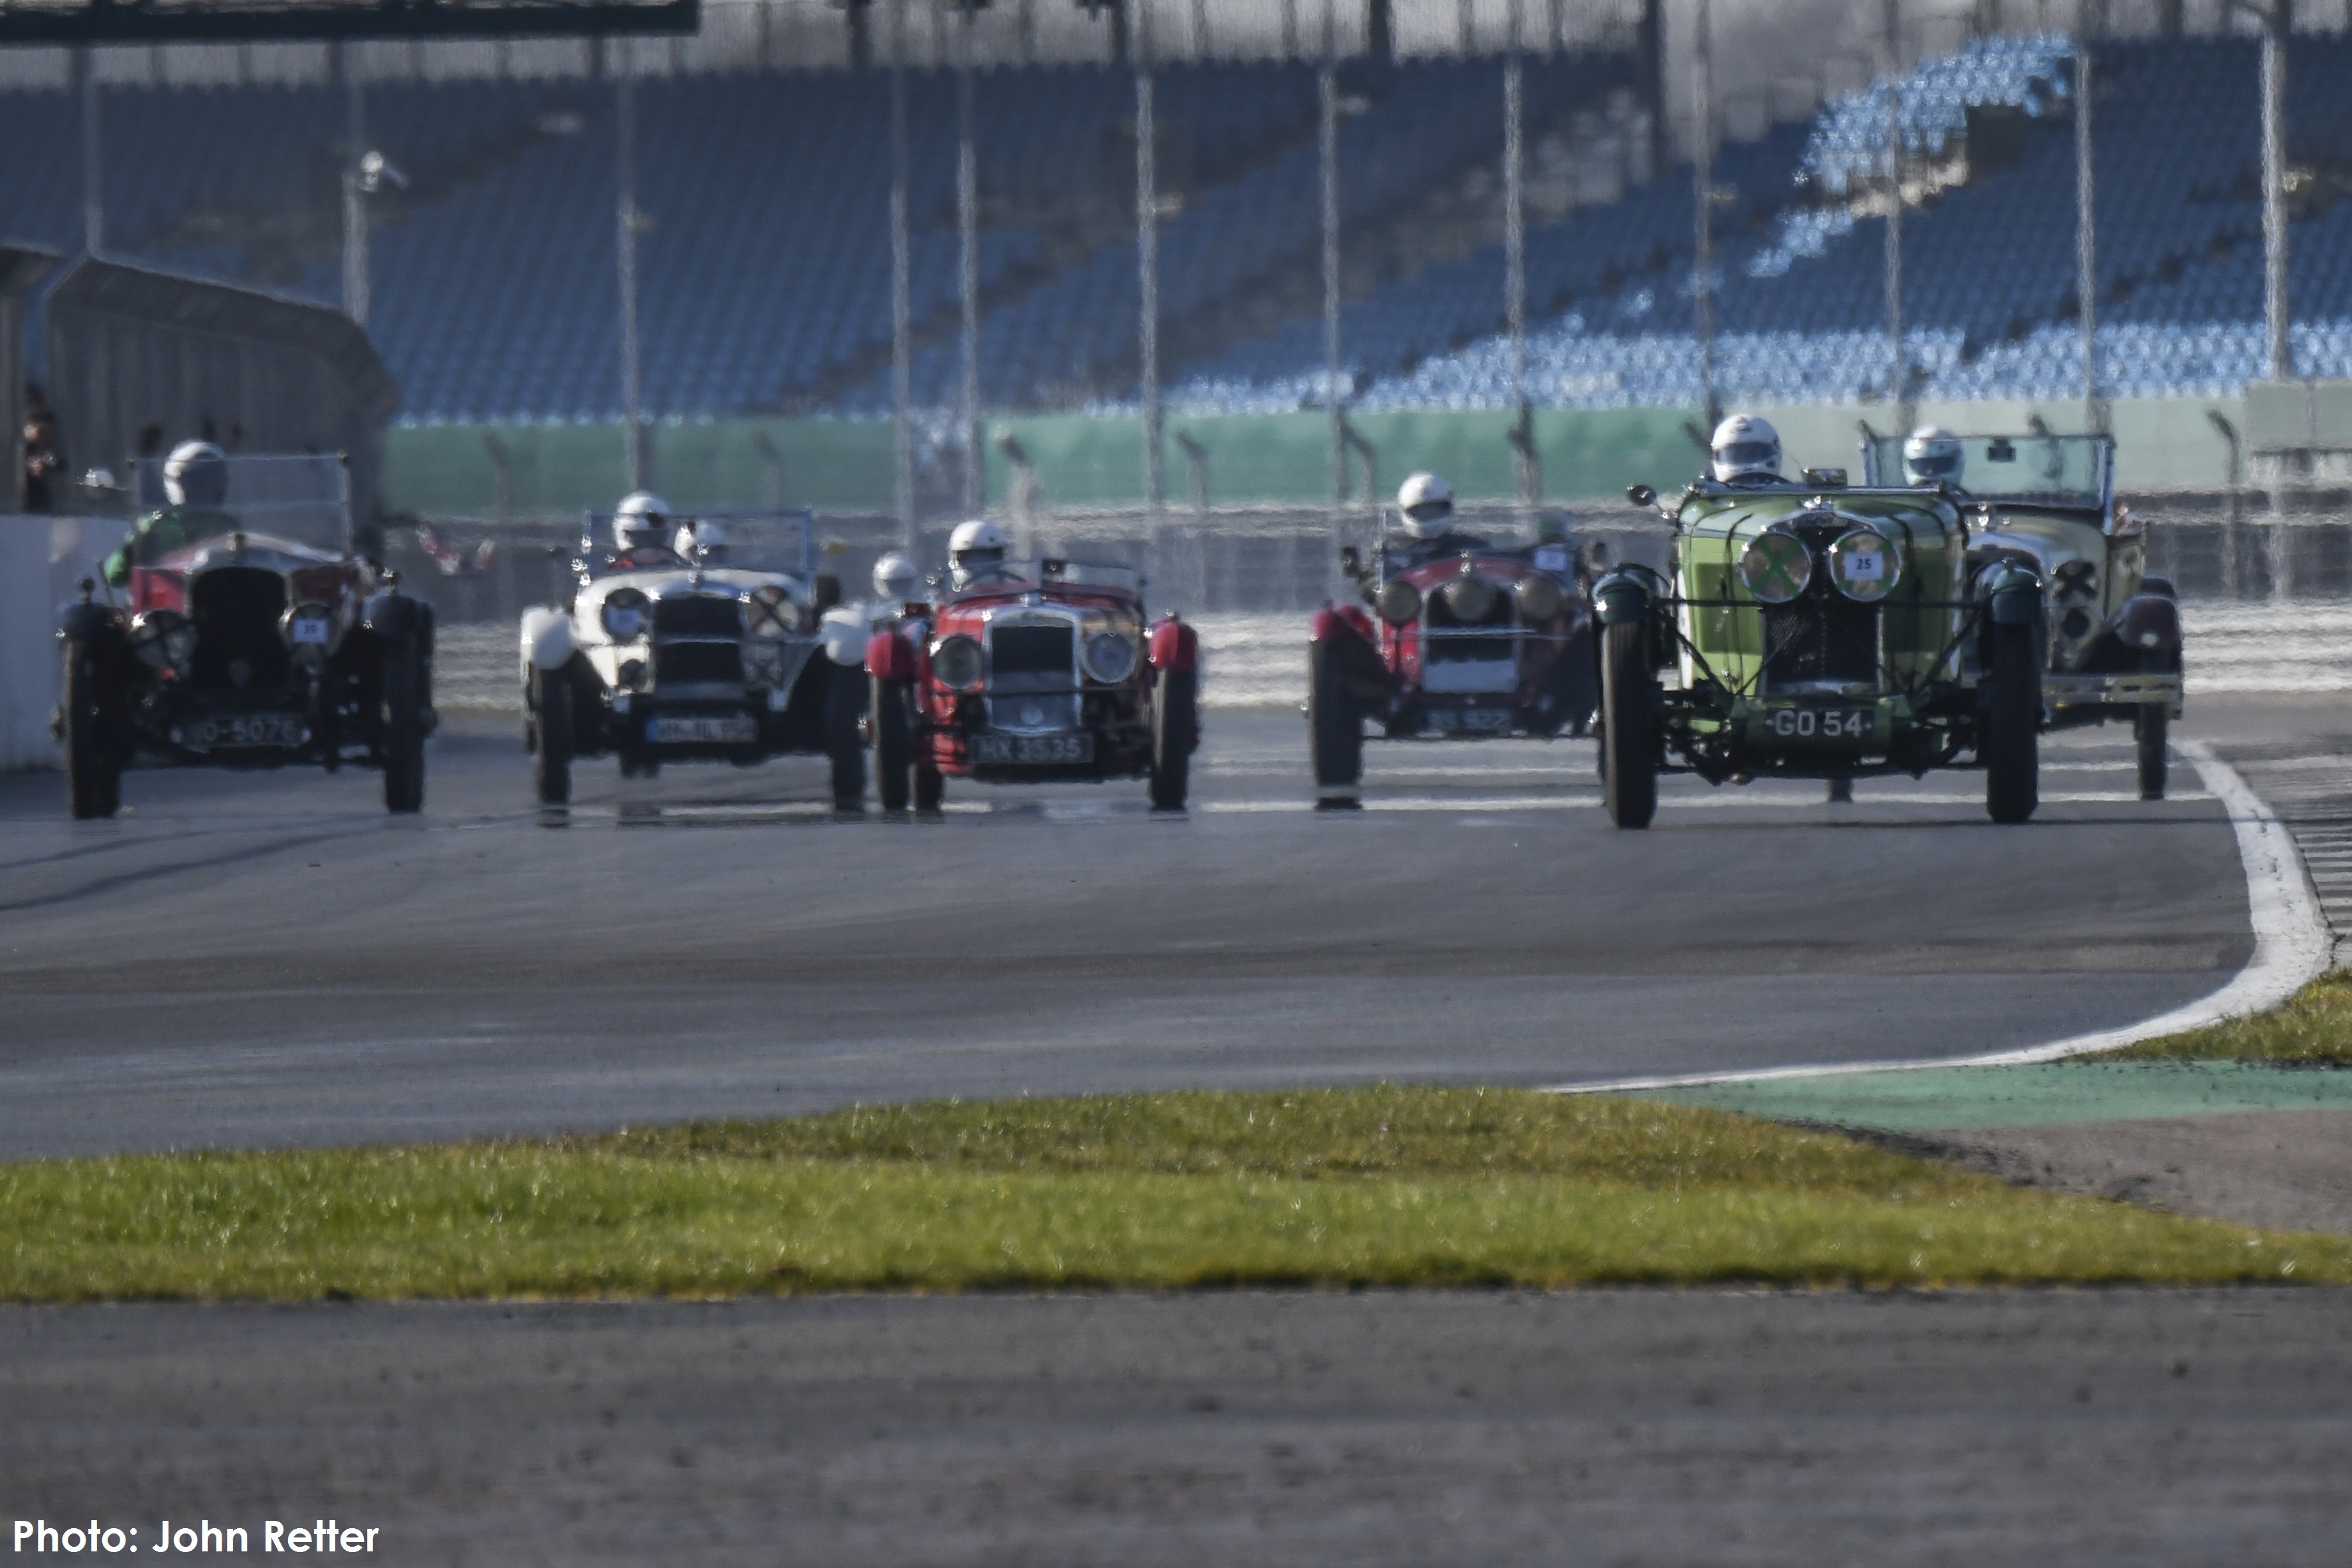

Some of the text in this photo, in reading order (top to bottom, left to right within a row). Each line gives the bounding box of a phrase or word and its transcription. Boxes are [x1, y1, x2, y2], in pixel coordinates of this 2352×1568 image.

[1855, 558, 1871, 570] 25
[1774, 710, 1862, 738] GO 54
